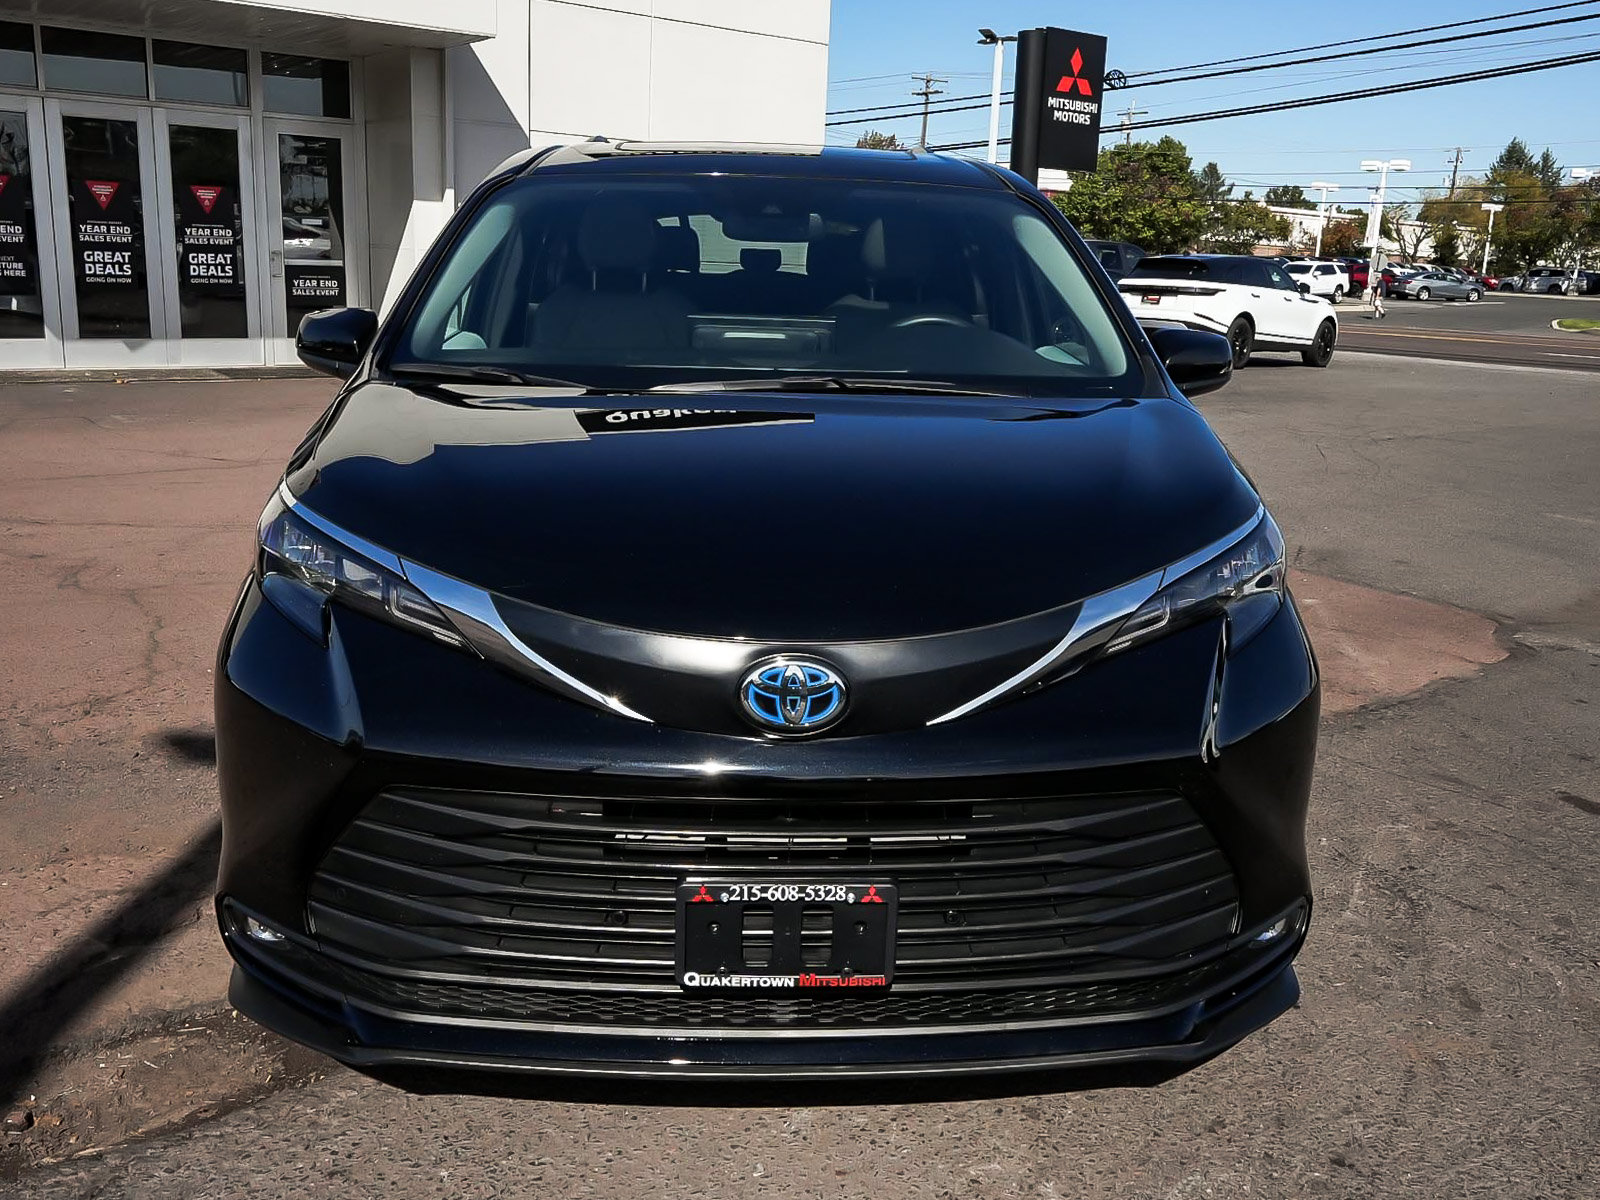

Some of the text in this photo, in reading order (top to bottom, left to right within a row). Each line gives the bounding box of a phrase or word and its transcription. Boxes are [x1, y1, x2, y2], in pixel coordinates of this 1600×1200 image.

[1047, 96, 1098, 114] MITSUBISHI
[1053, 110, 1091, 125] MOTORS
[0, 224, 22, 234] END
[79, 224, 131, 235] YEAR END
[184, 227, 233, 237] YEAR END
[0, 235, 25, 243] VENT
[79, 234, 132, 243] SALES EVENT
[184, 237, 234, 246] SALES EVENT
[83, 250, 132, 264] GREAT
[188, 252, 233, 265] GREAT
[0, 261, 24, 270] TURE
[84, 263, 132, 276] DEALS
[189, 264, 233, 277] DEALS
[3, 269, 27, 277] HERE
[293, 279, 338, 288] YEAR END
[292, 288, 340, 297] SALES EVENT
[729, 884, 847, 902] 215-608-5328
[683, 971, 887, 988] QUAKERTOWN MITSUBISHI
